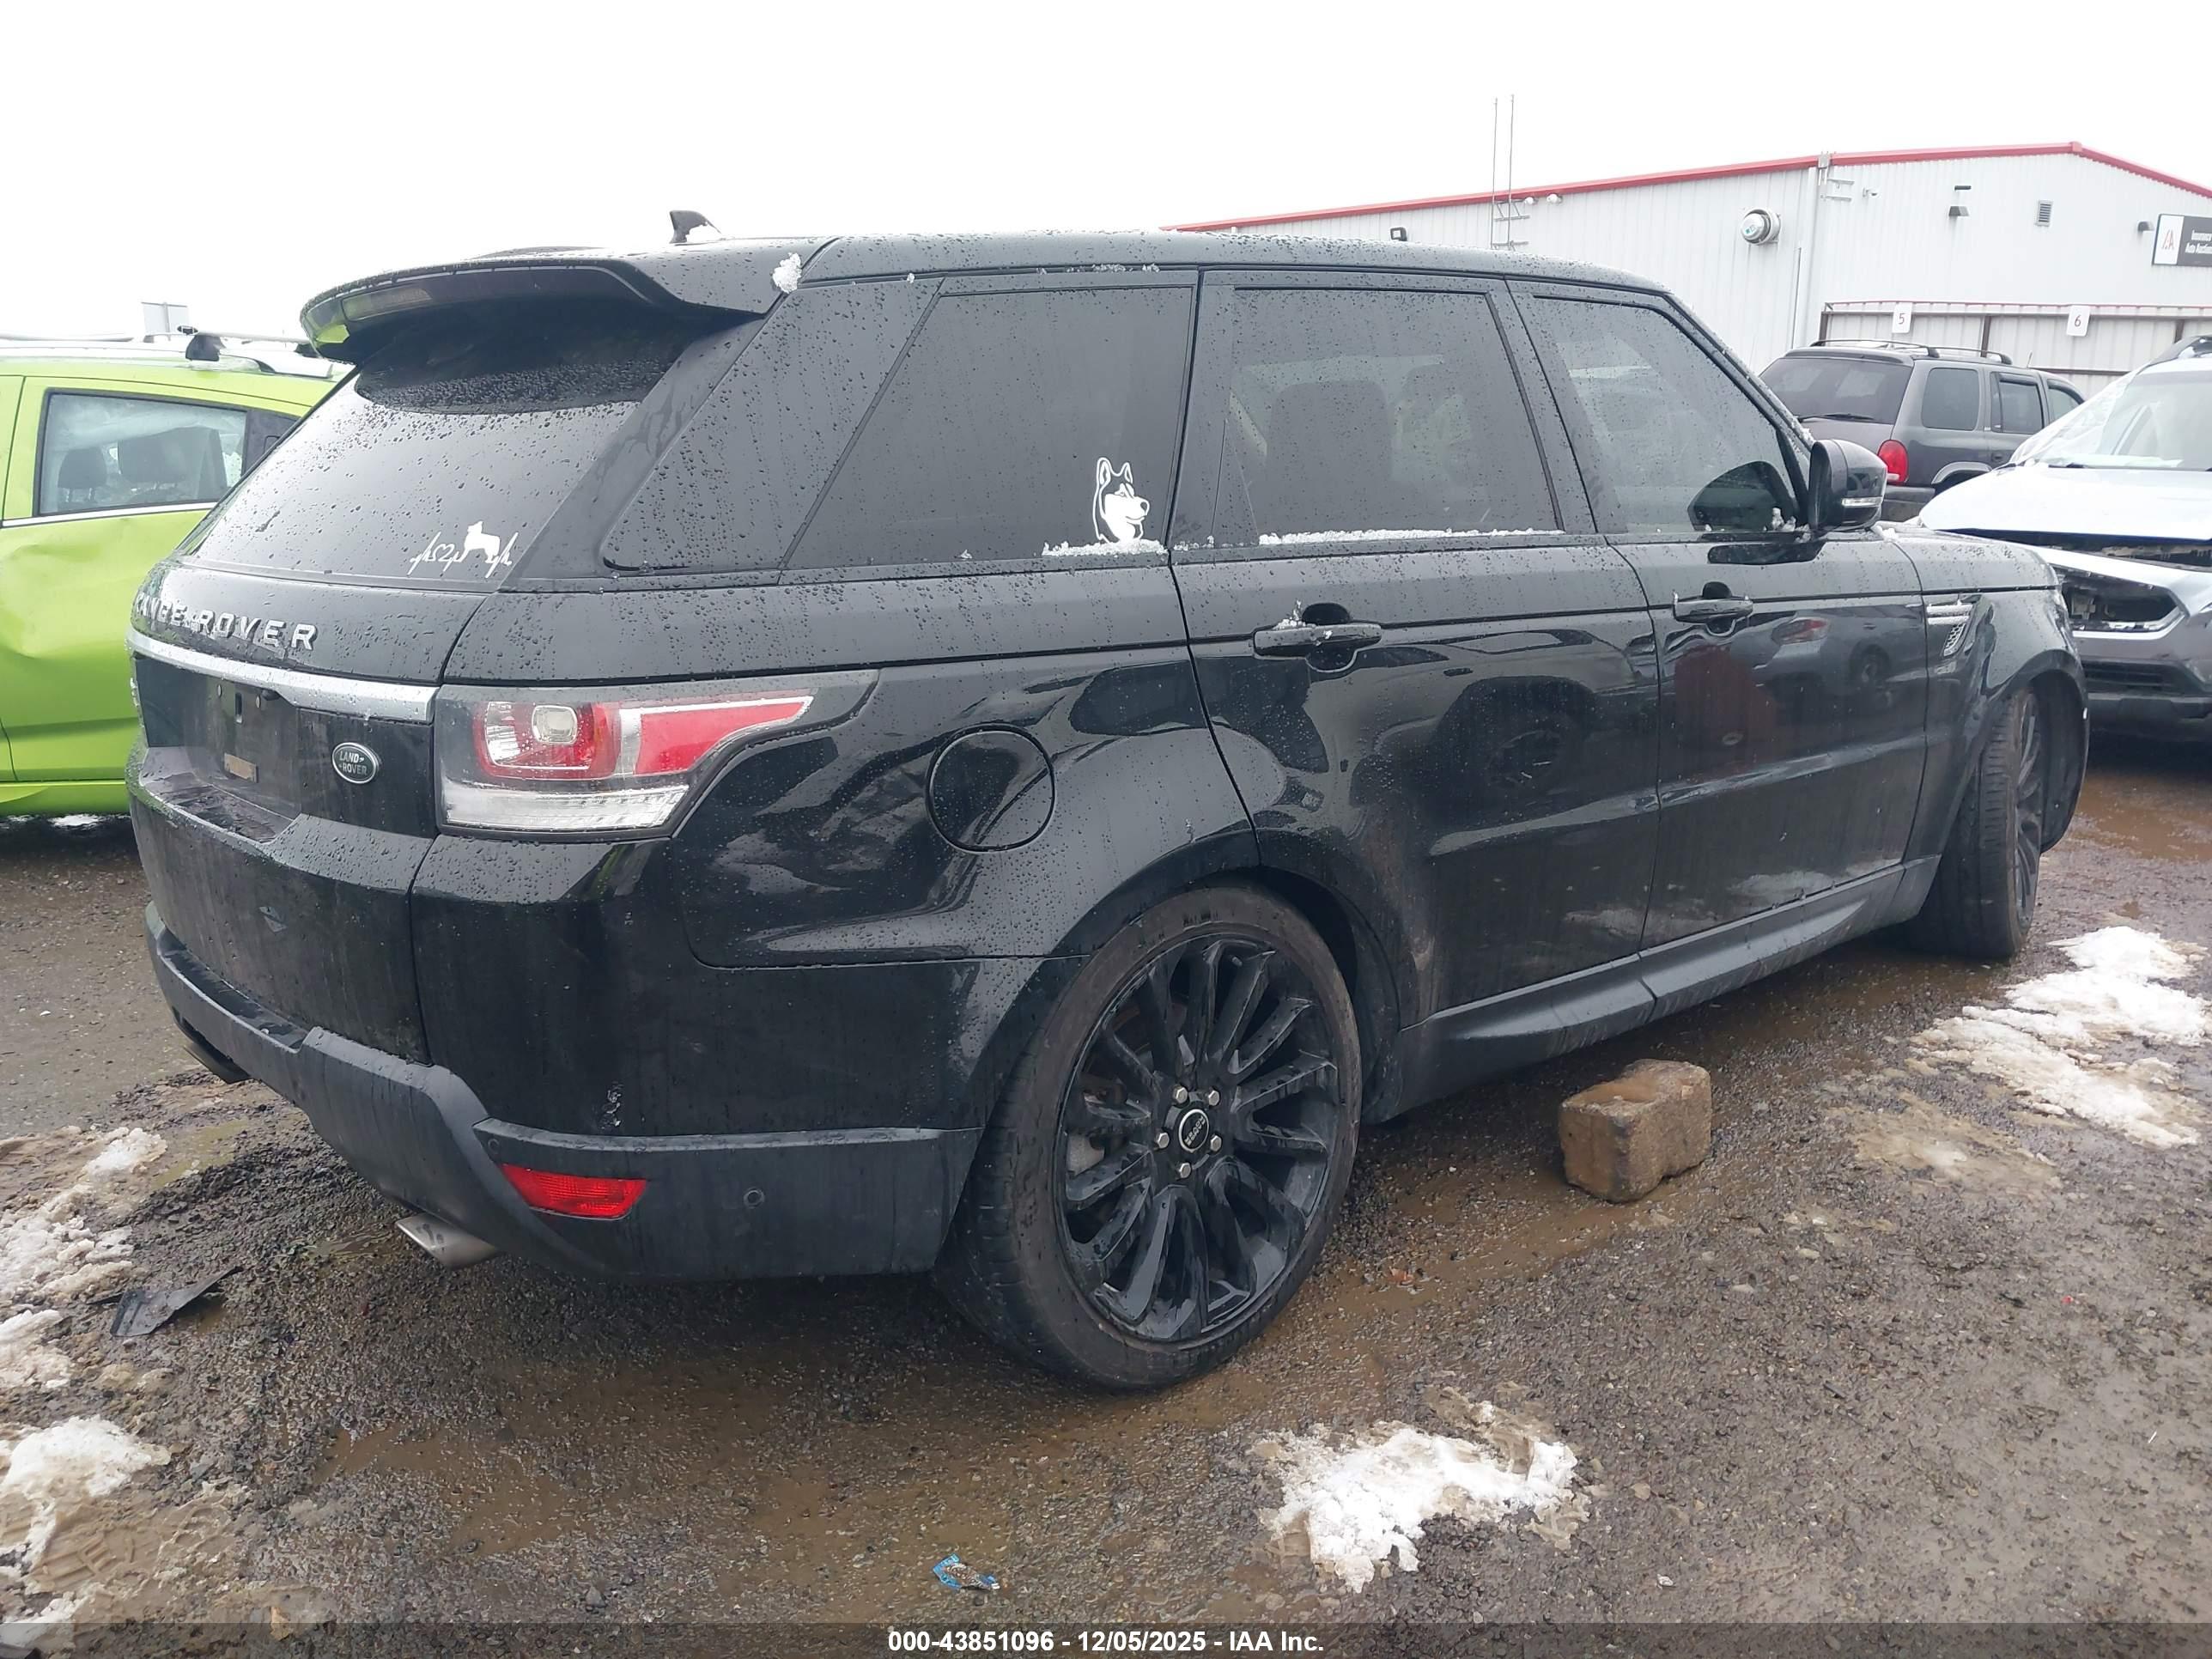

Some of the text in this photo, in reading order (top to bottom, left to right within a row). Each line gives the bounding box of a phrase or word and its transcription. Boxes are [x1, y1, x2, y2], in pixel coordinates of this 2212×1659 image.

[1898, 312, 1906, 325] 5
[2074, 314, 2081, 327] 6
[198, 609, 318, 651] ROVER
[339, 750, 360, 763] LAND
[342, 762, 368, 775] ROVER
